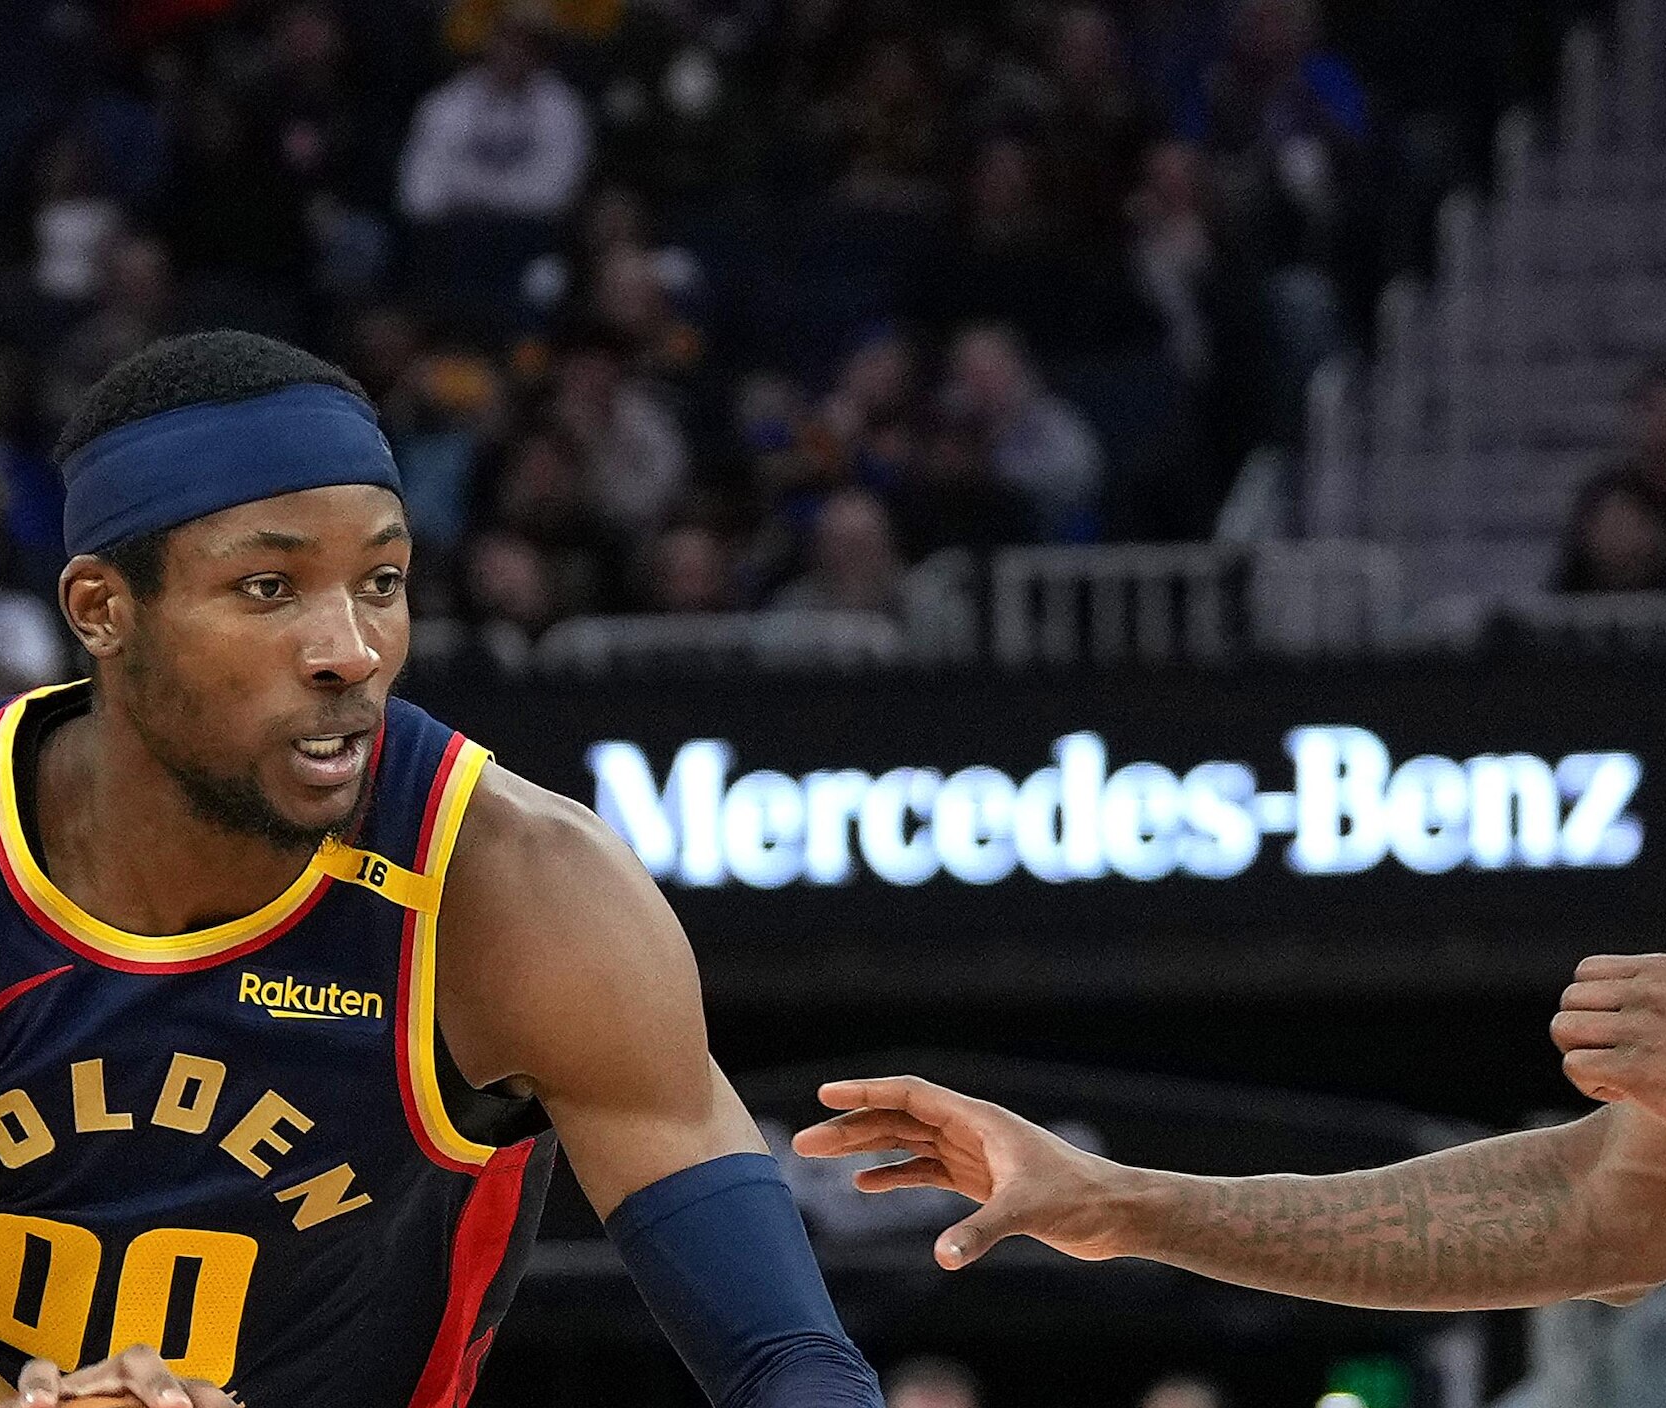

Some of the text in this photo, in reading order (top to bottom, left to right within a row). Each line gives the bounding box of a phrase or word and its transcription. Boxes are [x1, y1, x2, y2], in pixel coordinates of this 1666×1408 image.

[587, 724, 1643, 888] Mercedes-Benz
[356, 856, 388, 887] 16
[238, 971, 383, 1019] Rakuten
